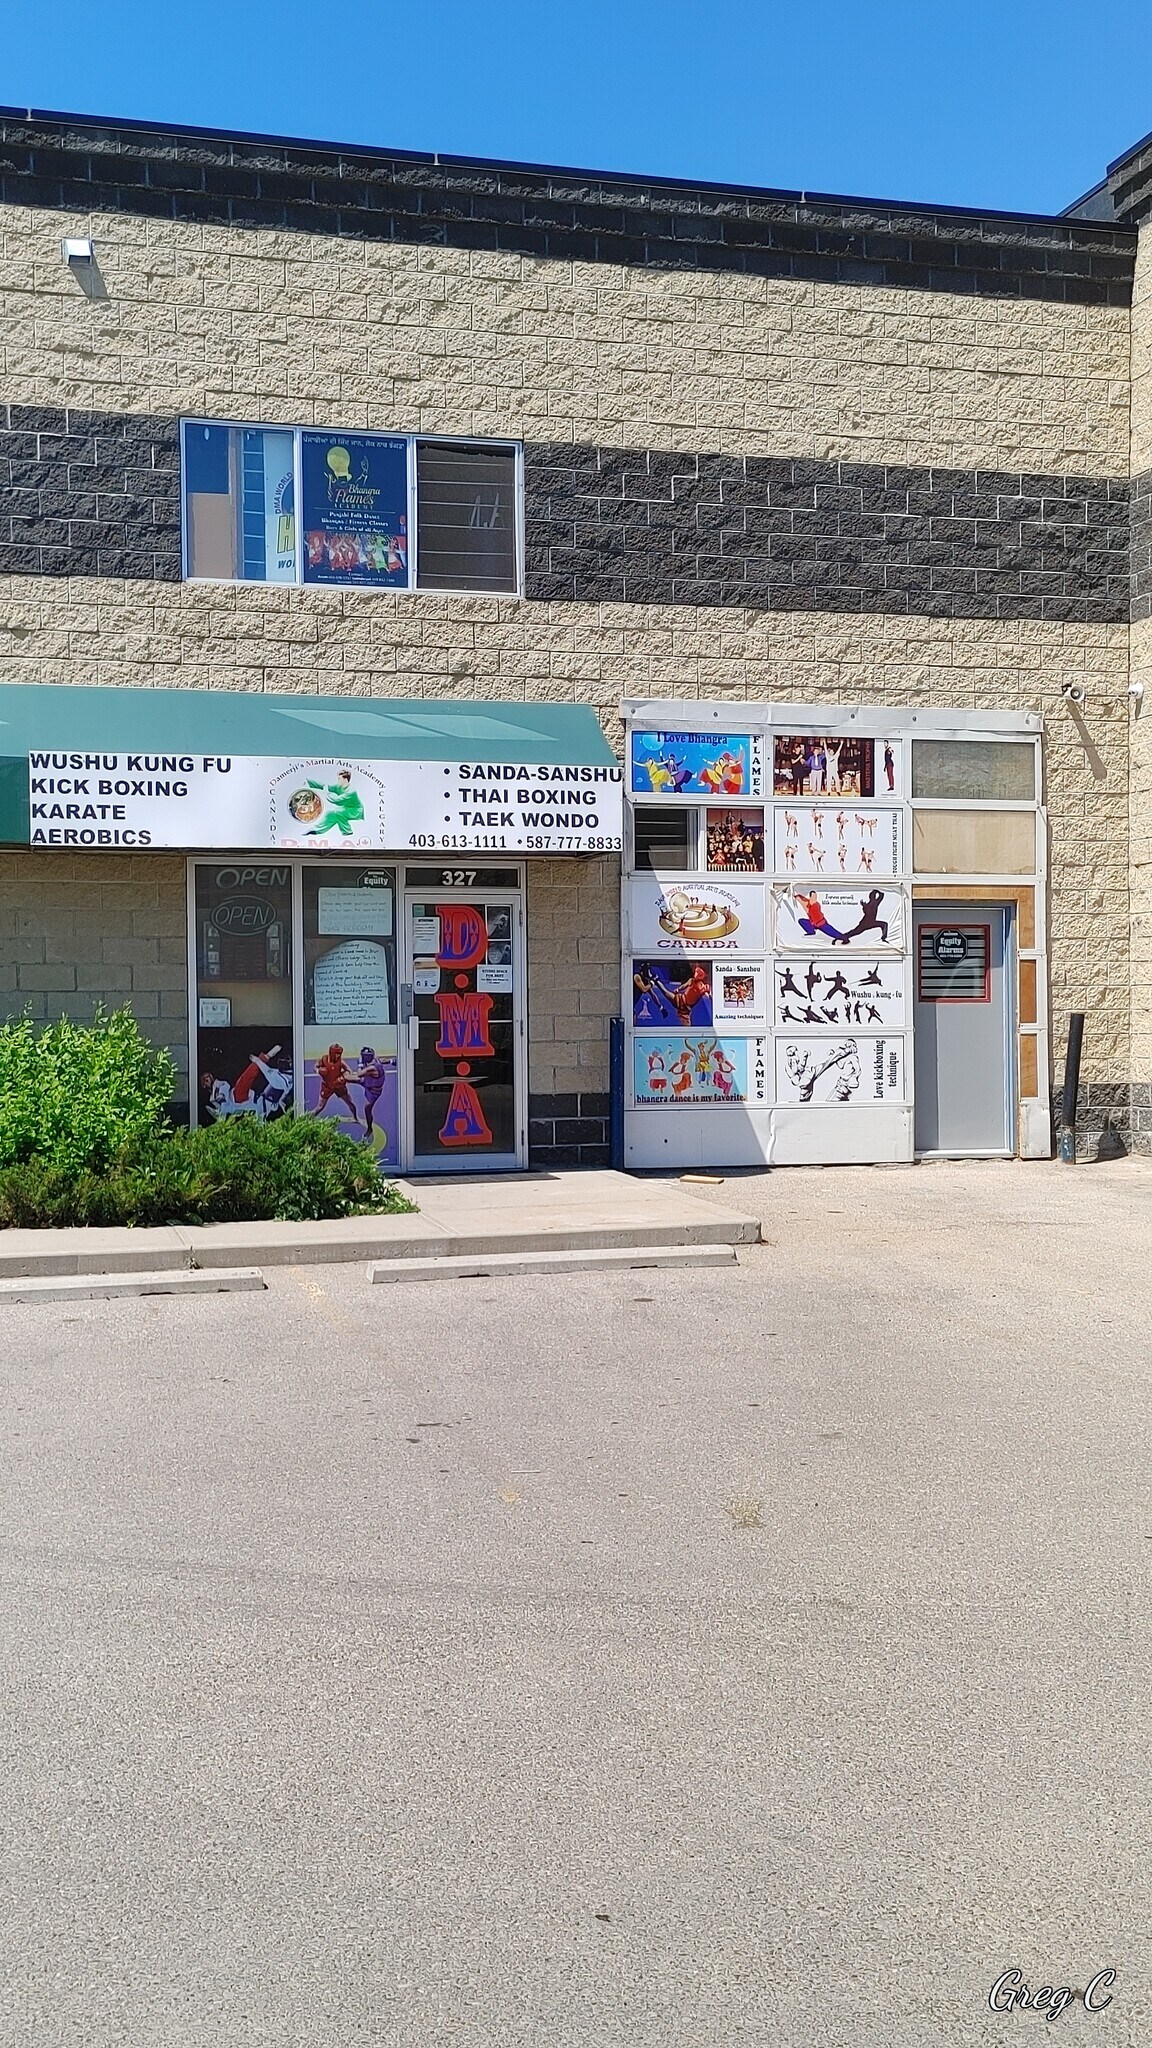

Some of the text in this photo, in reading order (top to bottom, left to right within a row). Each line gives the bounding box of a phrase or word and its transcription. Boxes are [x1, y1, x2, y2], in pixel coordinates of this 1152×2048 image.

[274, 471, 293, 515] DMA WORLD
[335, 488, 376, 504] Flames
[348, 483, 381, 497] Bhangra
[656, 732, 728, 746] I Love Bhangra
[30, 753, 232, 773] WUSHU KUNG FU
[751, 735, 762, 796] FLAMES
[269, 759, 387, 789] Damerji's Martial Arts Academy
[458, 764, 622, 783] SANDA-SANSHU
[31, 778, 188, 797] KICK BOXING
[458, 788, 597, 805] THAI BOXING
[32, 803, 126, 820] KARATE
[269, 789, 278, 841] CANADA
[378, 791, 386, 842] CALGARY
[458, 812, 599, 829] TAEK WONDO
[32, 828, 152, 845] AEROBICS
[408, 834, 622, 850] 403-613-1111 587-777-8833
[216, 868, 288, 888] OPEN
[364, 877, 388, 886] Equity
[442, 870, 477, 886] 327
[215, 906, 270, 925] OPEN
[657, 940, 739, 949] CANADA
[937, 946, 964, 954] Alarms
[940, 937, 962, 946] Equity
[715, 965, 761, 973] Sanda Sanshou
[851, 990, 872, 998] Wushu
[755, 1038, 765, 1099] FLAMES
[873, 1040, 886, 1099] Love kickboxing
[887, 1051, 900, 1088] technique
[636, 1093, 668, 1103] bhangra
[669, 1093, 692, 1103] dance
[693, 1093, 700, 1102] is
[701, 1095, 713, 1103] my
